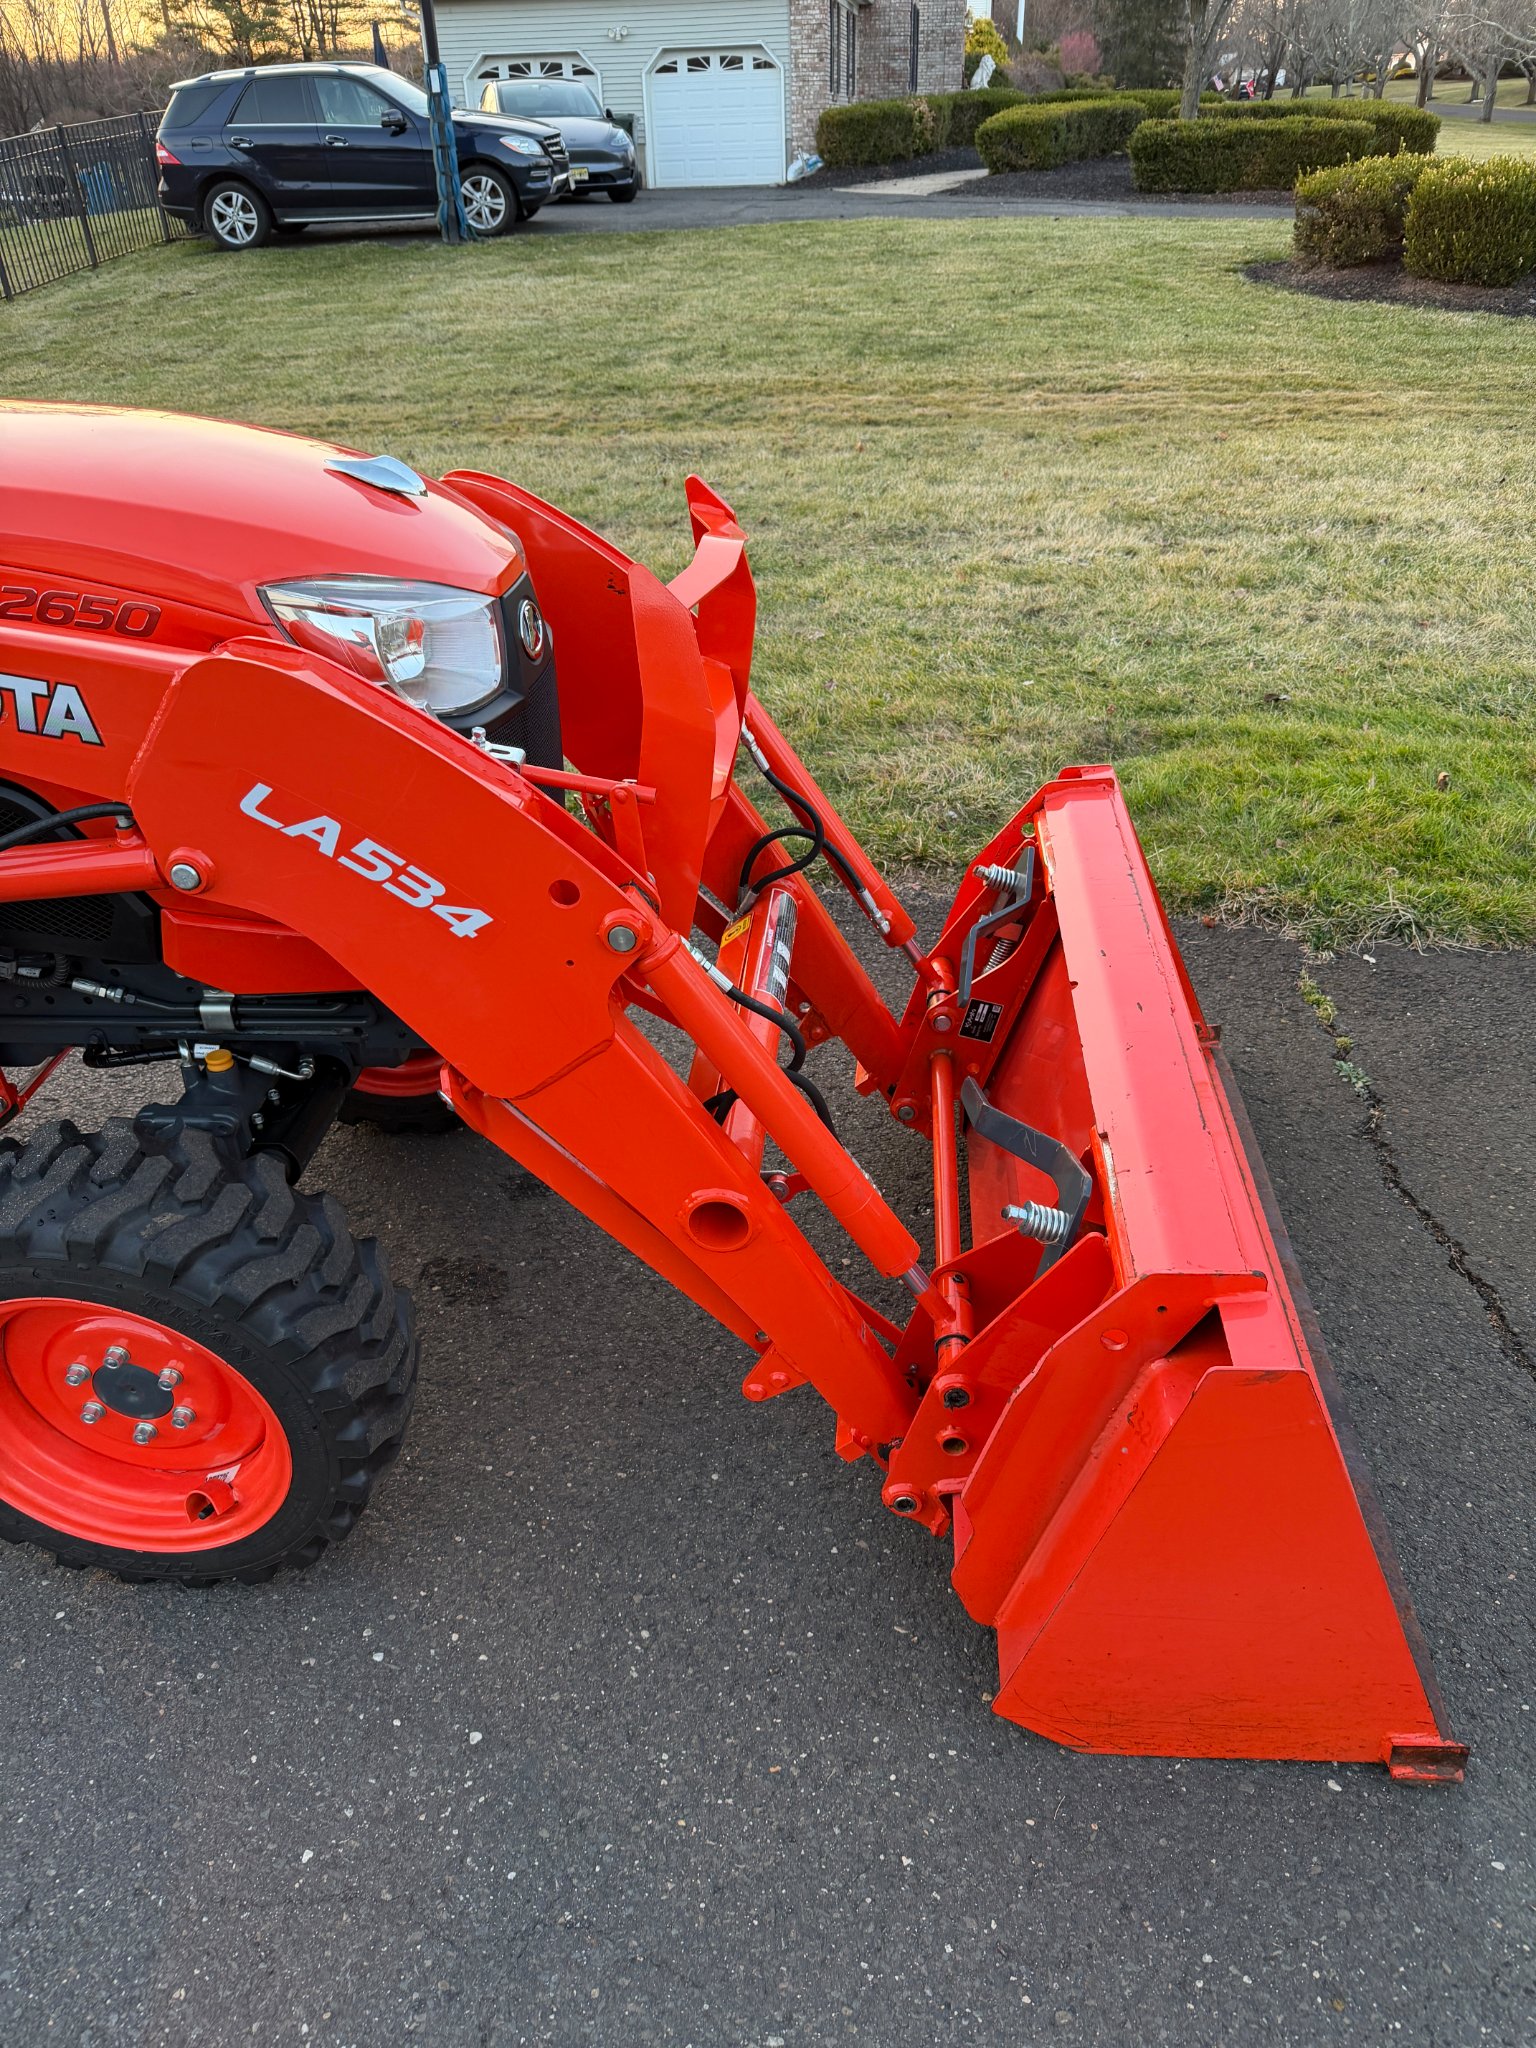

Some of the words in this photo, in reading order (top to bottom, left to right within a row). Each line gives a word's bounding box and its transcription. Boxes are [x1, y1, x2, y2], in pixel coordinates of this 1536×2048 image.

[0, 586, 161, 637] 2650
[0, 672, 105, 747] TA
[239, 782, 494, 939] LA534
